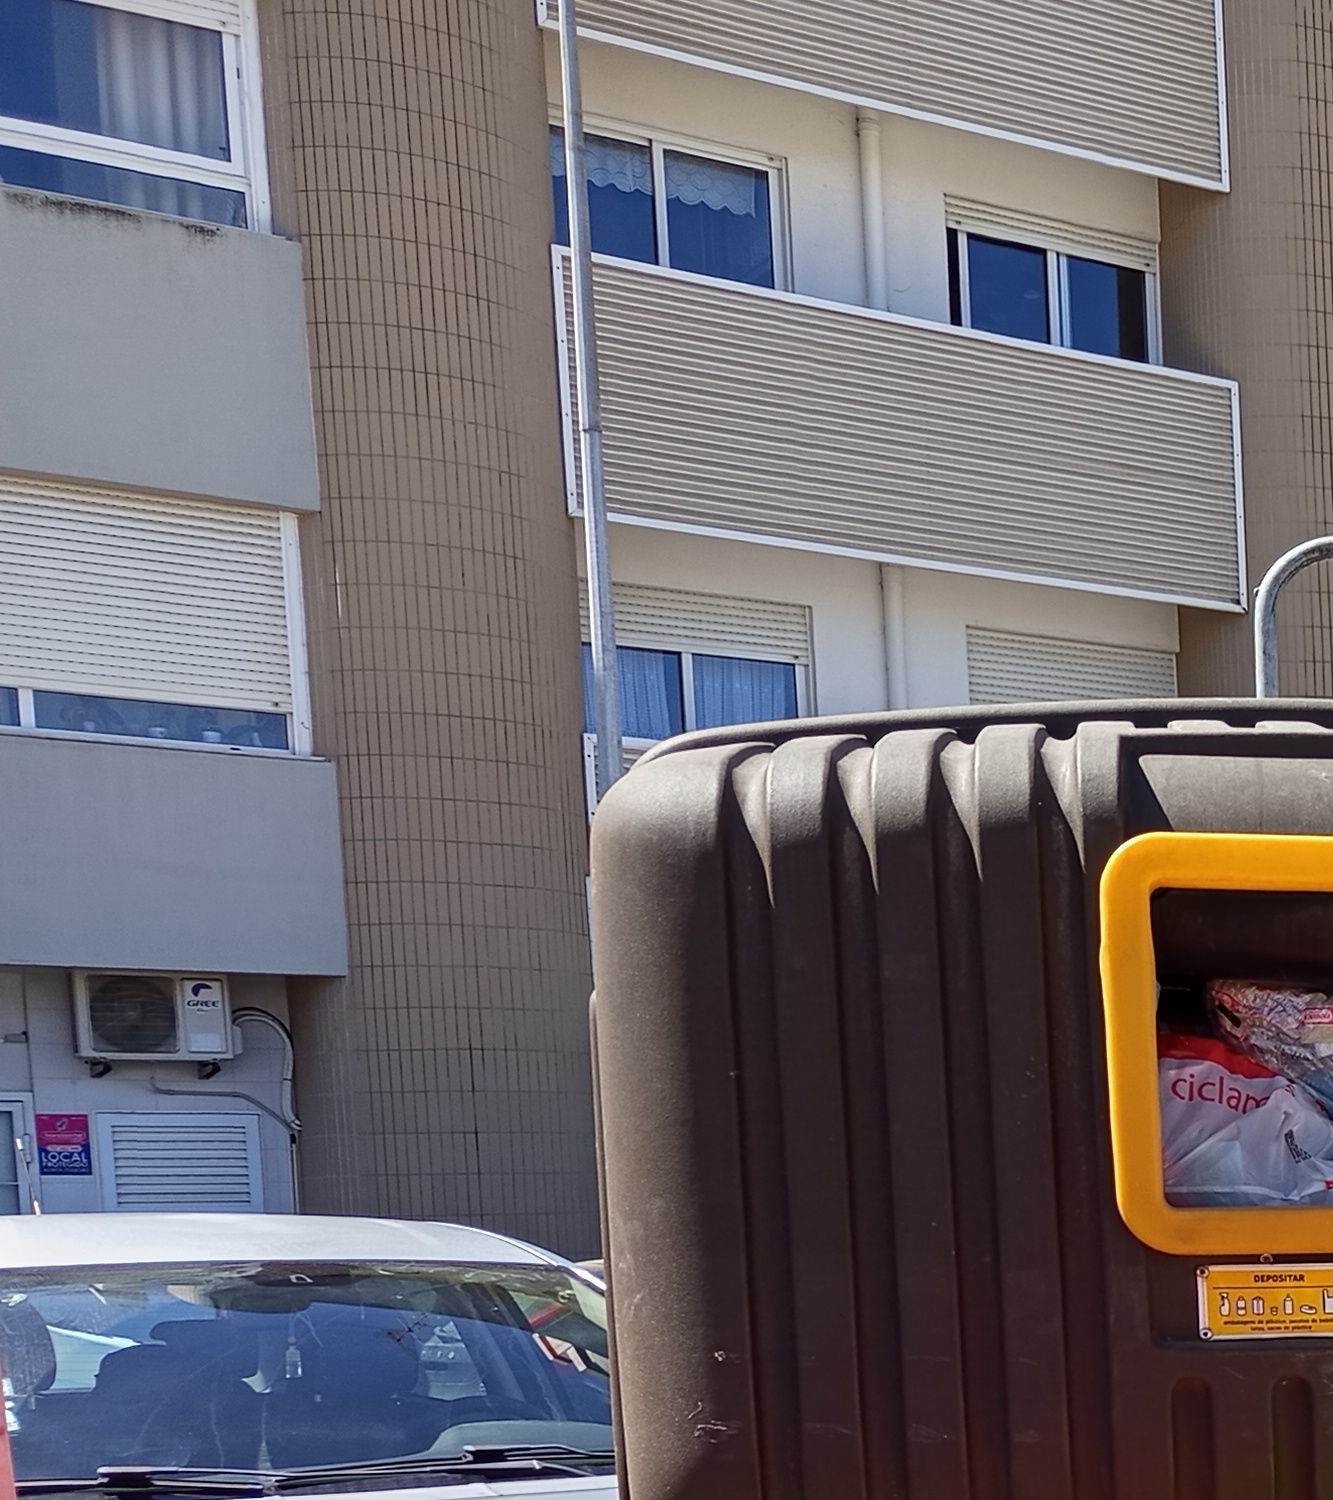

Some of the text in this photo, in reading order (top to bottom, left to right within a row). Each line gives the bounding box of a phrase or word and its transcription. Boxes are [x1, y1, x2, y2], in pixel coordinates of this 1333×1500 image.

[186, 999, 220, 1008] GREE
[41, 1151, 88, 1163] LOCAL
[1253, 1273, 1306, 1283] DEPOSITAR
